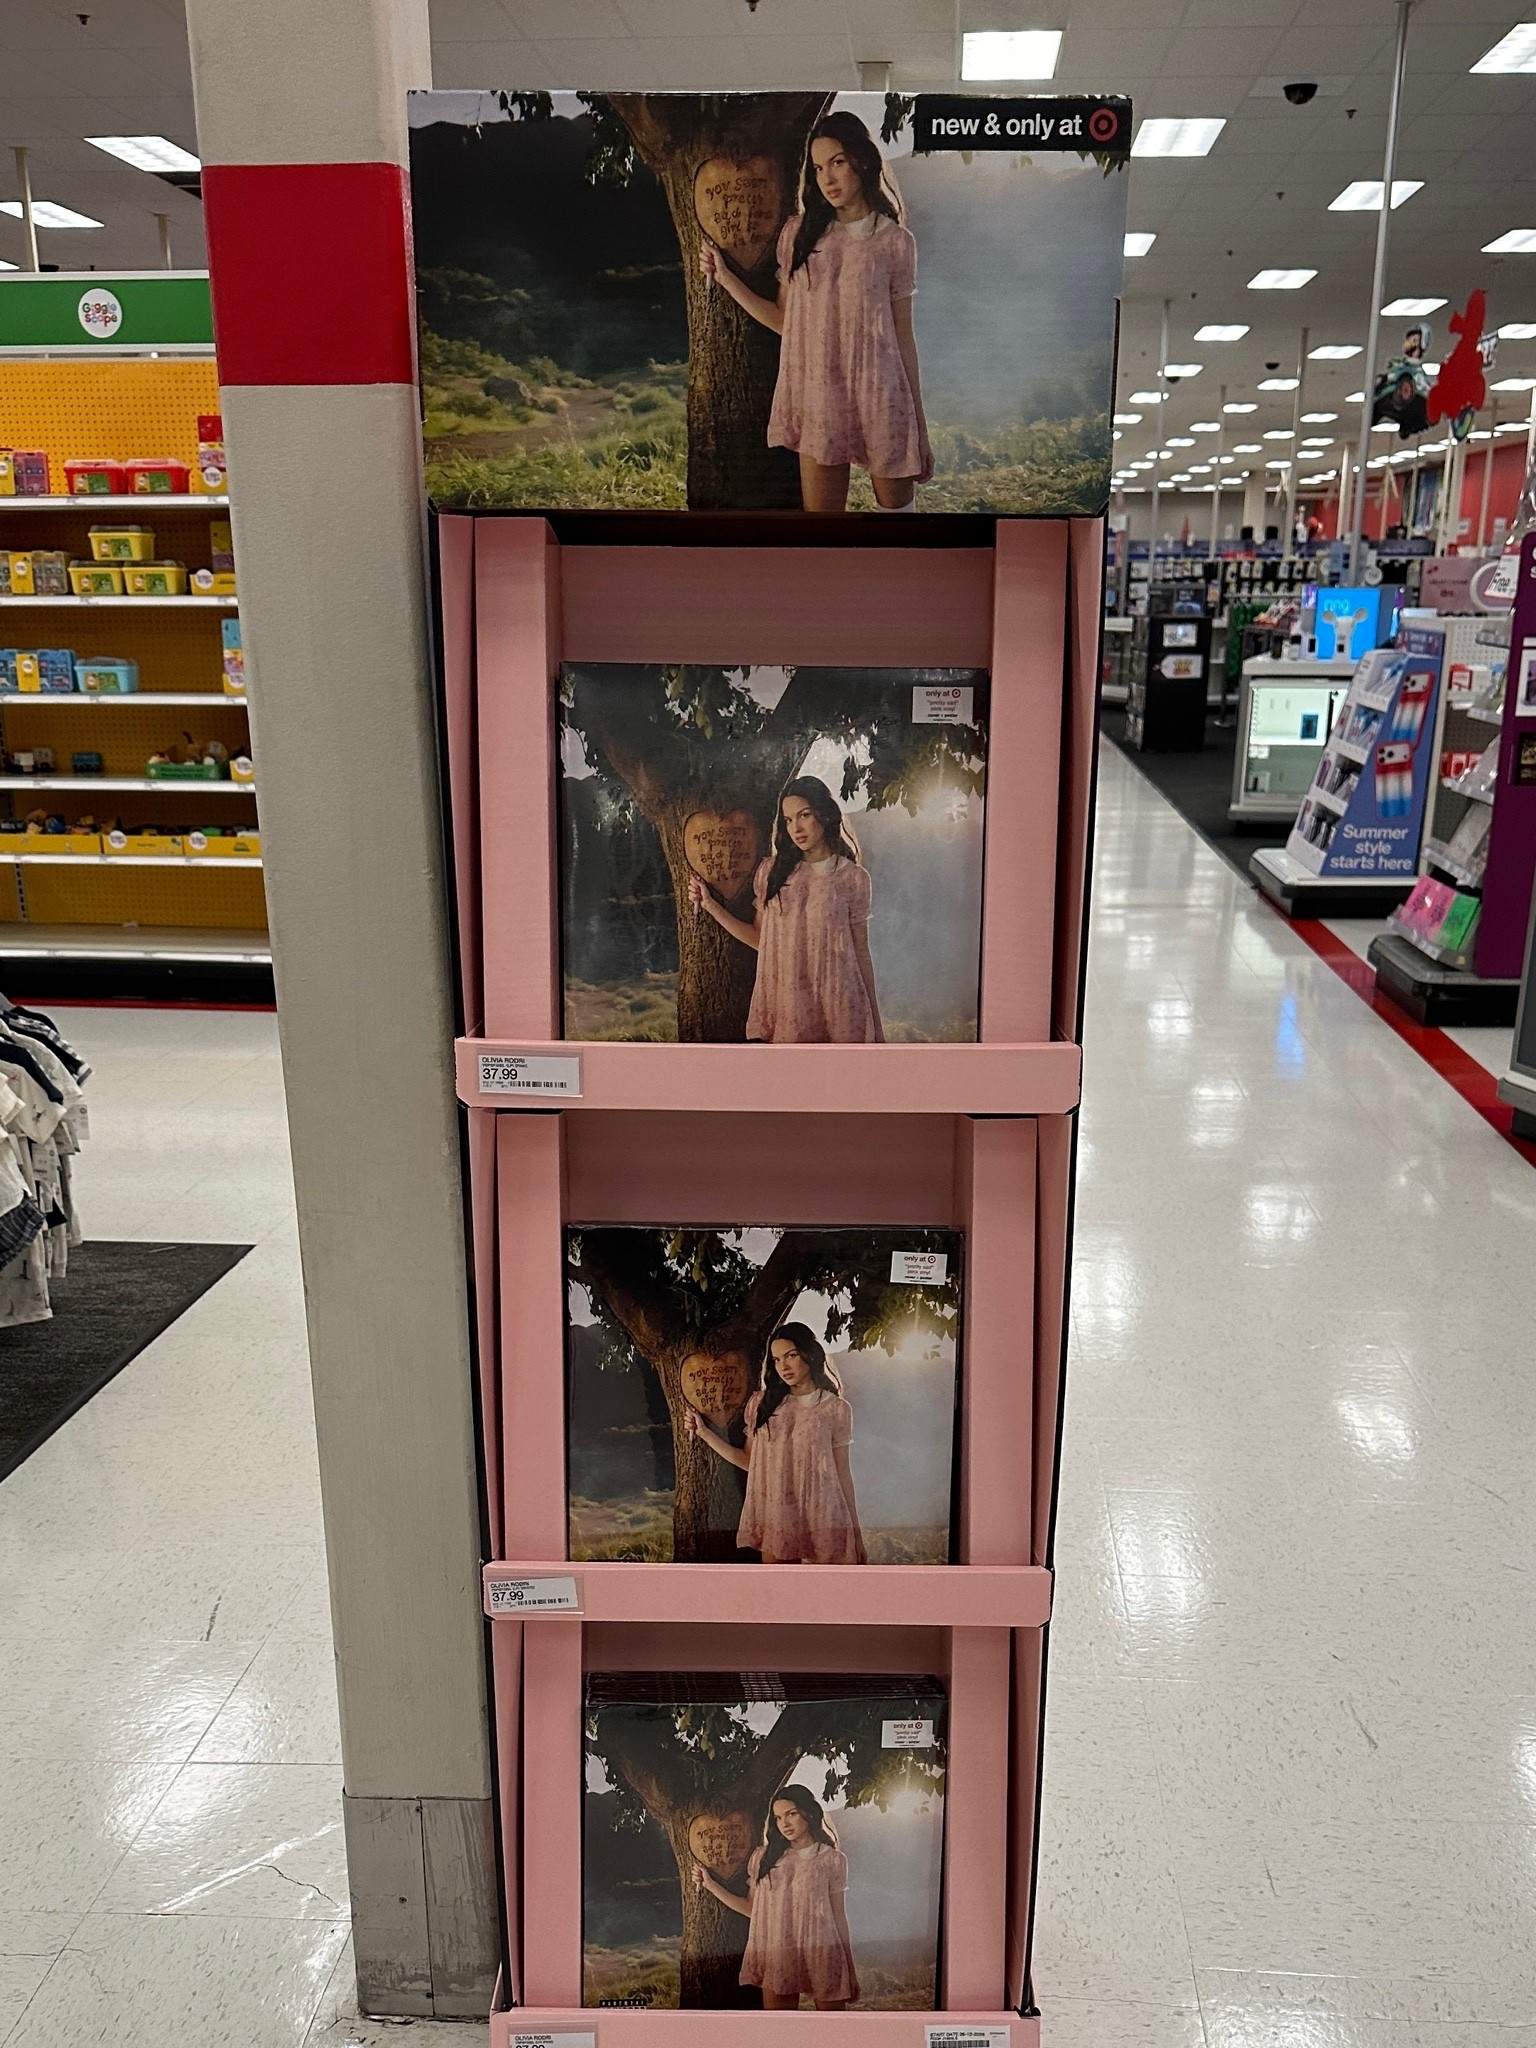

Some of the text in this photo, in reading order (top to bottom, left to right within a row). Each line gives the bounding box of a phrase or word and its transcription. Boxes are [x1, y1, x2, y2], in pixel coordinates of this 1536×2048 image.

[931, 113, 1083, 140] new & only at
[705, 181, 731, 201] you
[925, 690, 942, 698] only
[693, 828, 716, 845] you
[1342, 823, 1409, 840] Summer
[1354, 840, 1392, 857] style
[1329, 855, 1413, 871] starts here
[482, 1067, 518, 1080] 37.99
[904, 1255, 918, 1263] only
[688, 1367, 709, 1382] you
[491, 1590, 524, 1602] 37.99
